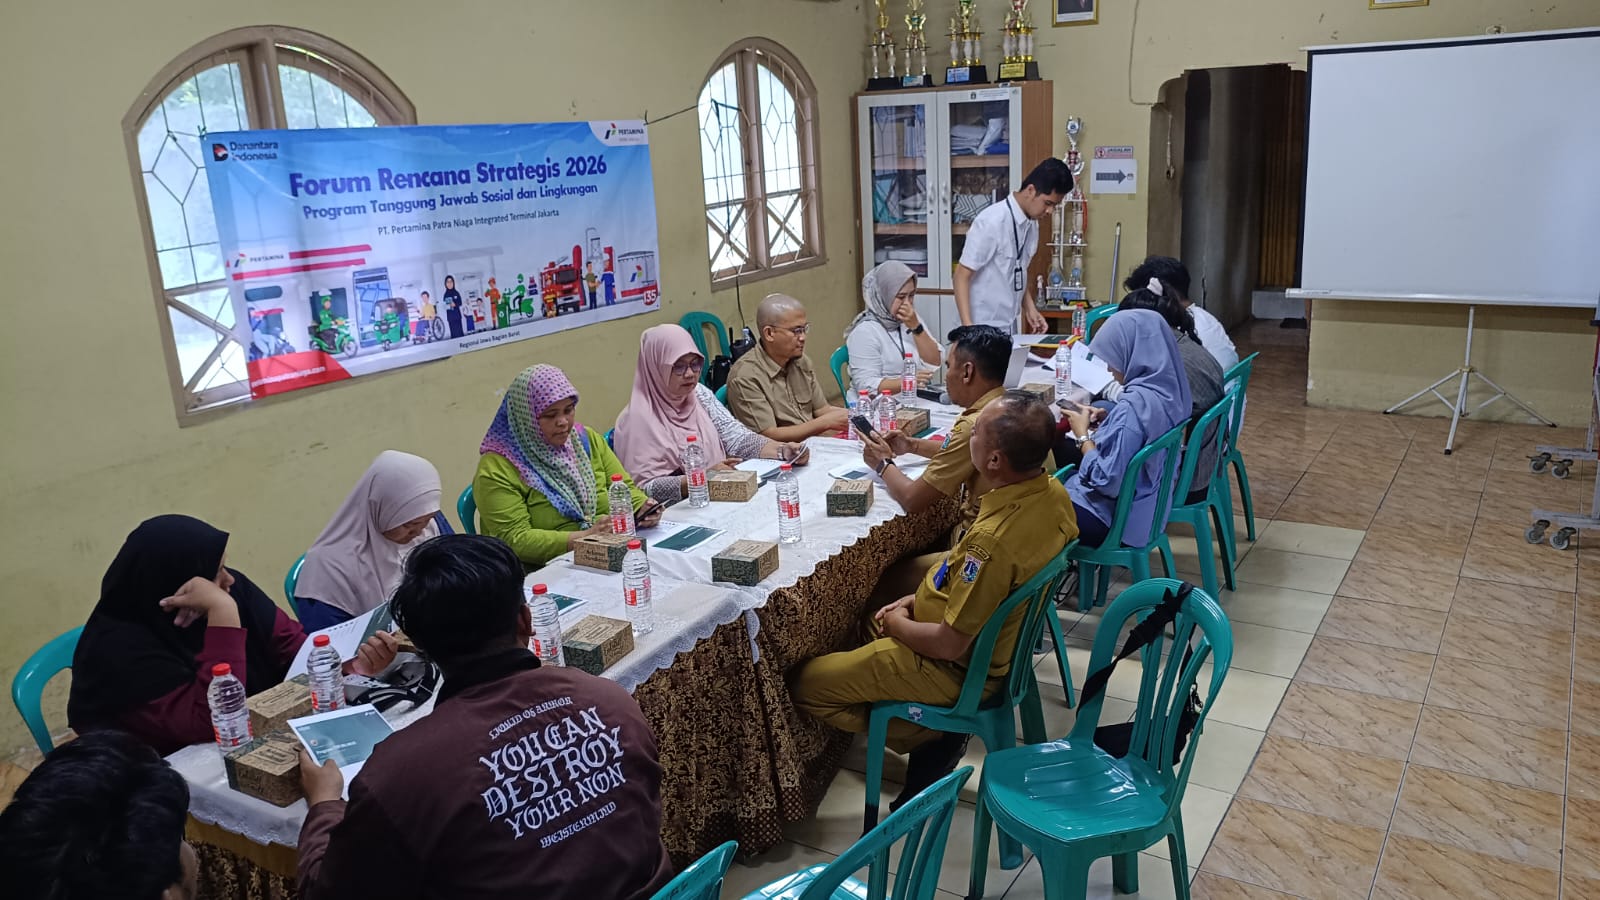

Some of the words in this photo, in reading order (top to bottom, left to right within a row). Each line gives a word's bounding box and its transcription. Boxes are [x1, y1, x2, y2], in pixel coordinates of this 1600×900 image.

[229, 141, 278, 151] Danantara
[231, 152, 278, 161] Indonesia
[289, 172, 371, 198] Forum
[378, 168, 471, 190] Rencana
[476, 157, 561, 184] Strategis
[565, 154, 607, 177] 2026
[303, 203, 366, 220] Program
[370, 198, 436, 214] Tanggung
[439, 192, 478, 207] Jawab
[481, 188, 513, 203] Sosial
[517, 187, 536, 200] dan
[540, 183, 598, 199] Lingkungan
[378, 226, 390, 236] PT.
[391, 222, 431, 235] Pertamina
[433, 219, 452, 230] Patra
[453, 217, 473, 229] Niaga
[474, 214, 509, 226] Integrated
[510, 210, 537, 221] Terminal
[537, 208, 560, 219] Jakarta
[643, 289, 658, 303] 135
[479, 731, 547, 783] YOU
[544, 706, 606, 750] CAN
[481, 725, 624, 822] DESTROY
[504, 788, 578, 840] YOUR
[575, 762, 626, 805] NON
